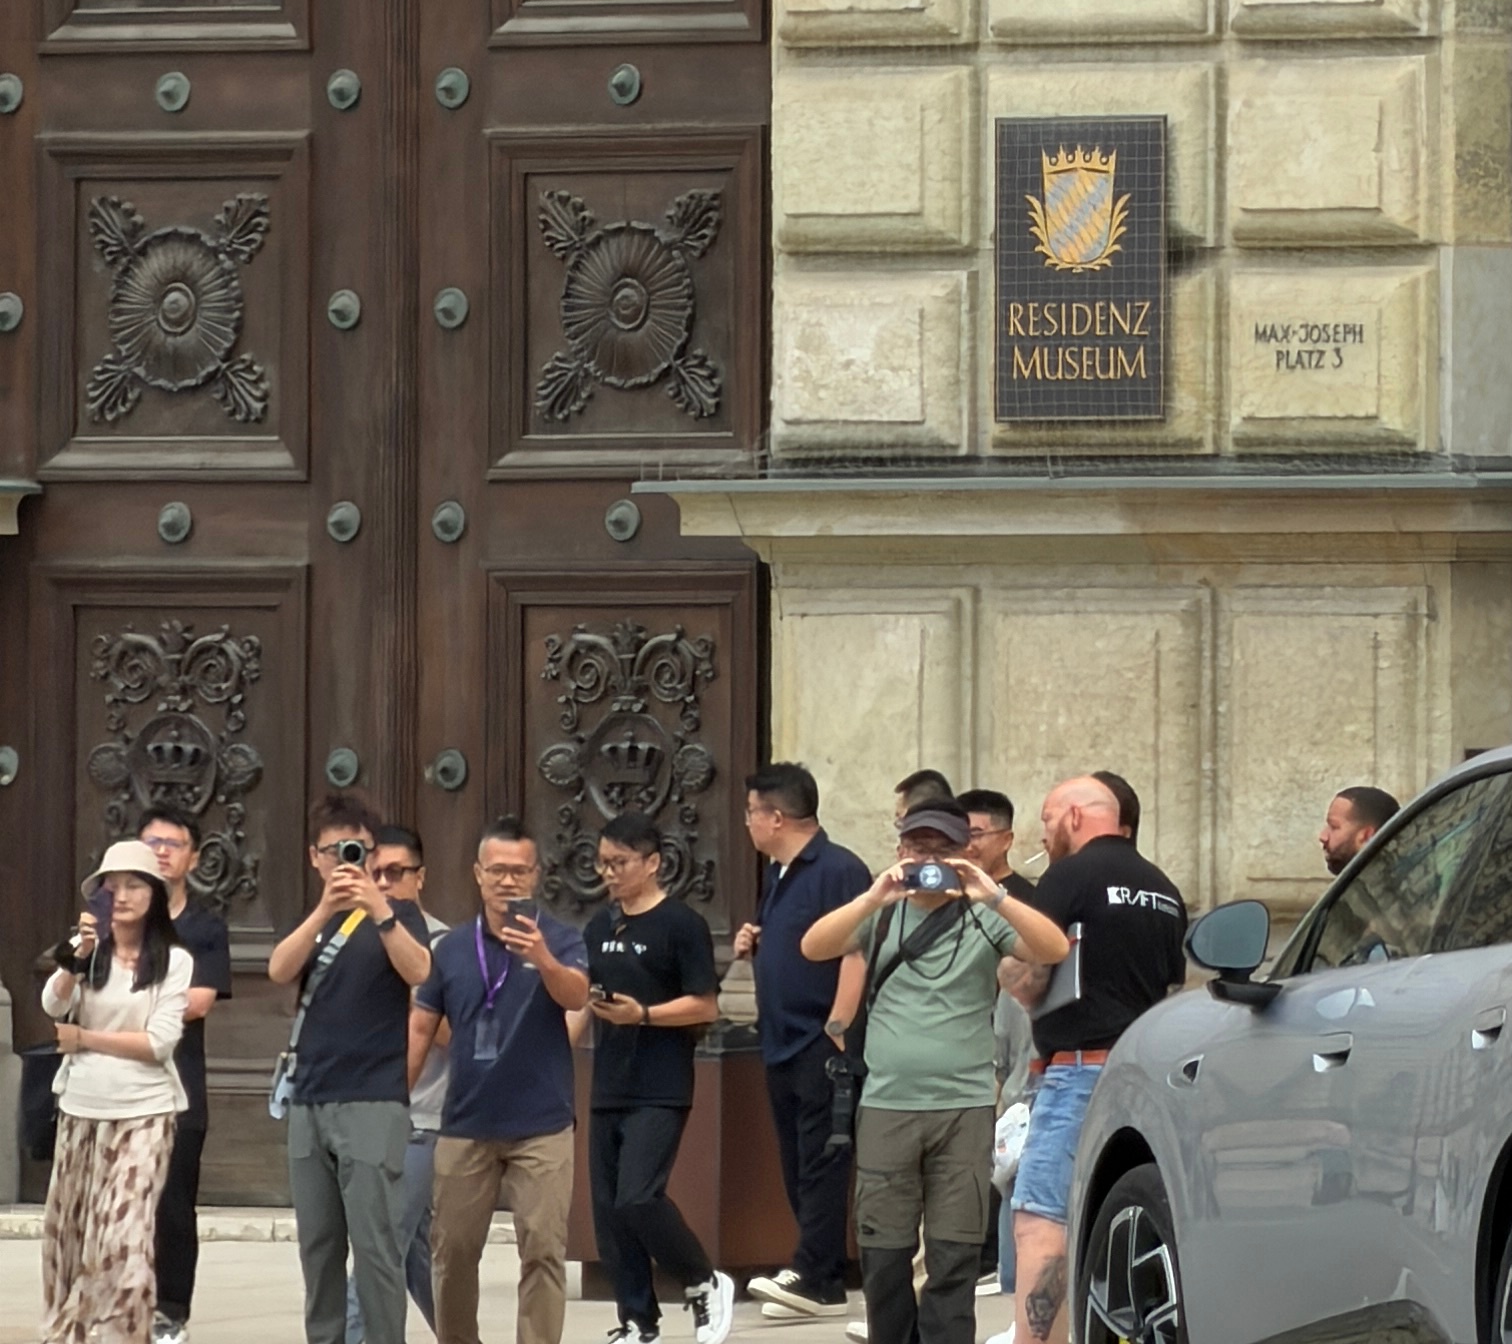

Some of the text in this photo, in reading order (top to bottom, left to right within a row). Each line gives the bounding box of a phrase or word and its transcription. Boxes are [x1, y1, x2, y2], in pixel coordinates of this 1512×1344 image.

[1008, 300, 1152, 337] RESIDENZ
[1012, 345, 1148, 381] MUSEUM
[1275, 346, 1344, 371] PLATZ 3
